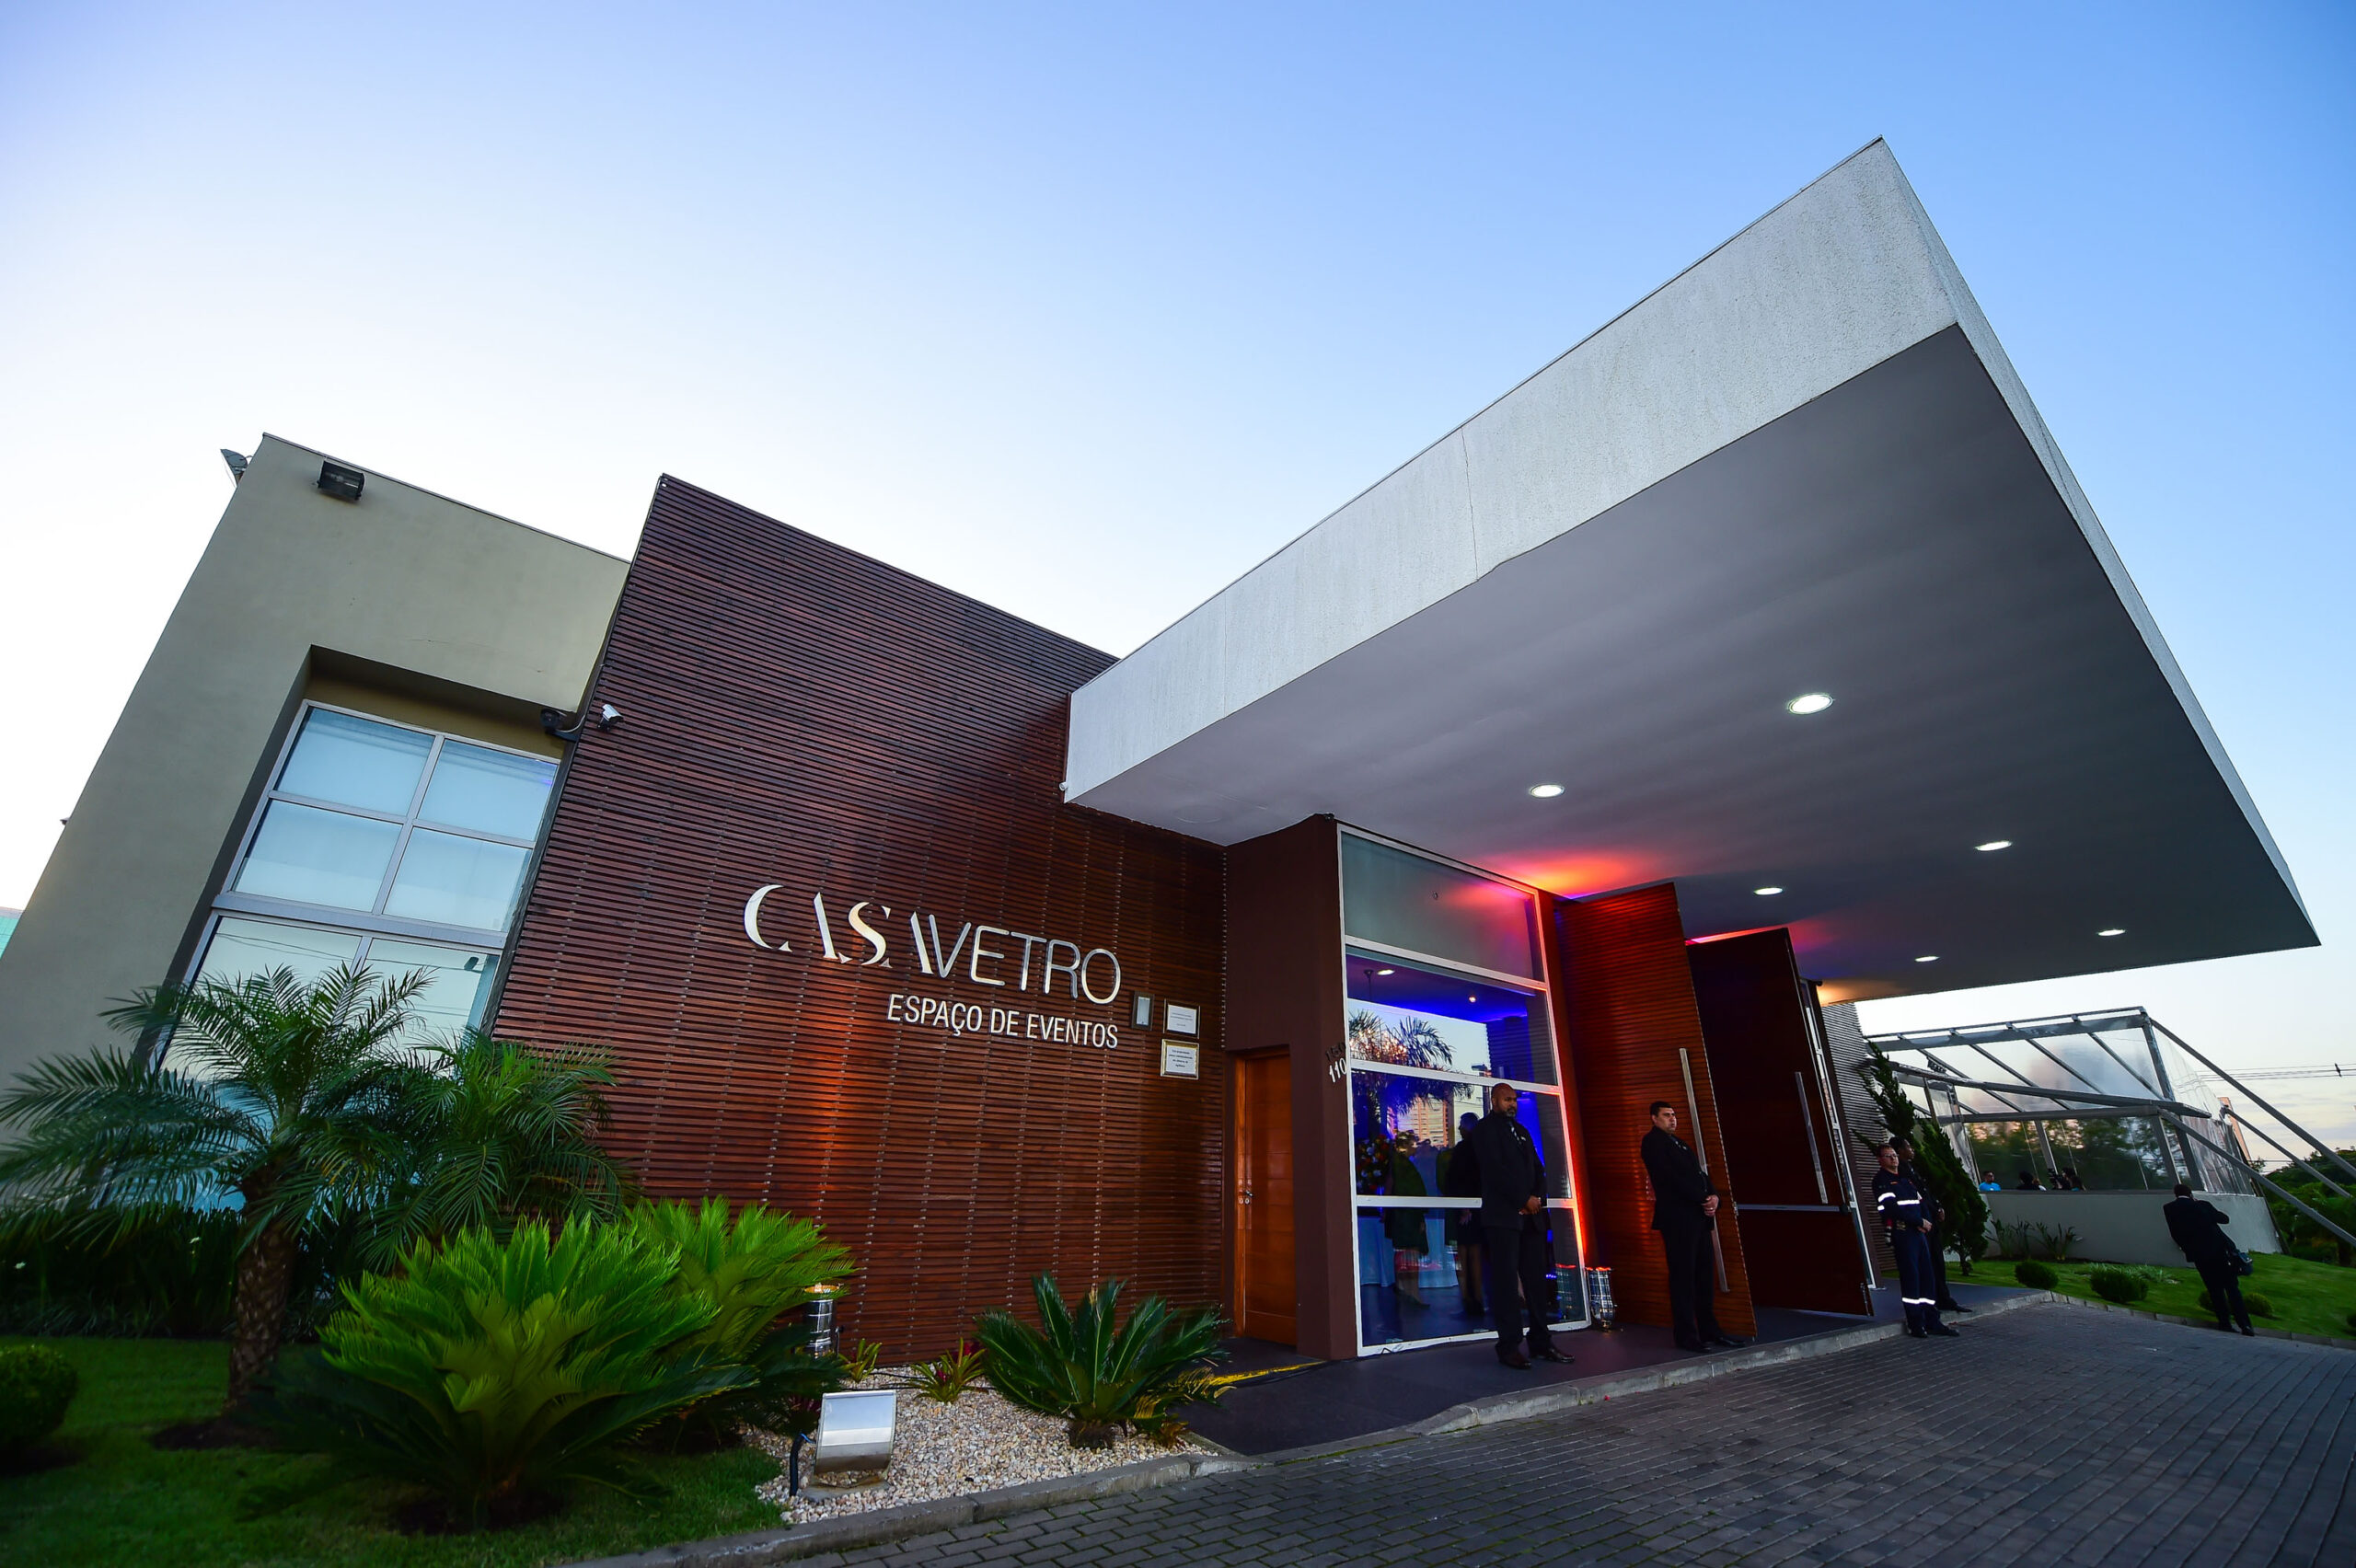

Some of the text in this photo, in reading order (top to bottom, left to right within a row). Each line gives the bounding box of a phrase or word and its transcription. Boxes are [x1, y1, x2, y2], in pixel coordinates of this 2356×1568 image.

[886, 993, 1118, 1049] ESPAÇO DE EVENTOS
[1329, 1057, 1346, 1083] 110
